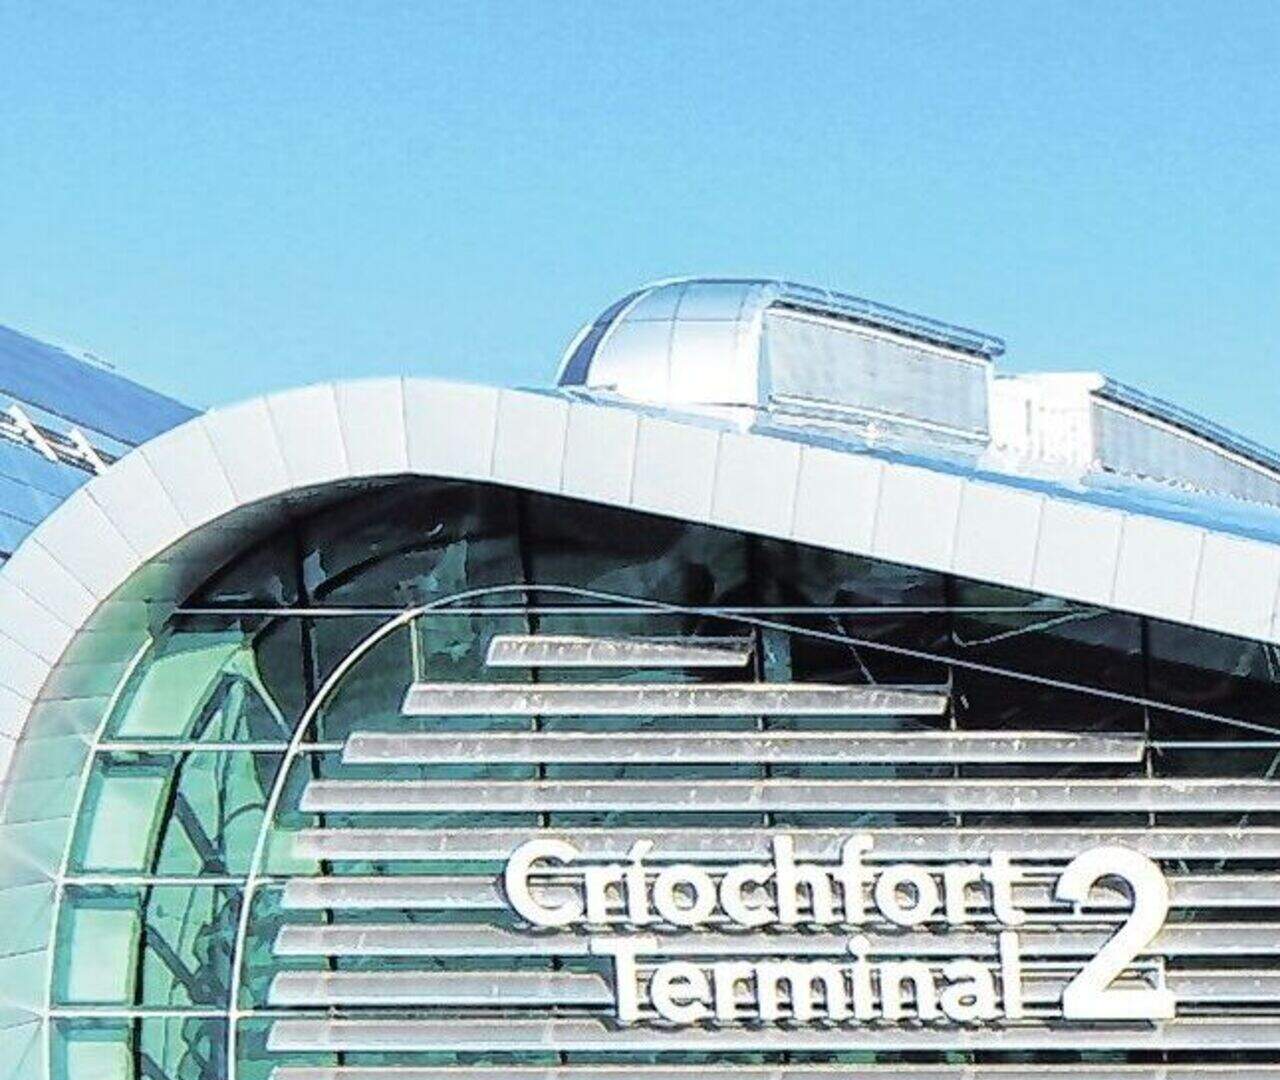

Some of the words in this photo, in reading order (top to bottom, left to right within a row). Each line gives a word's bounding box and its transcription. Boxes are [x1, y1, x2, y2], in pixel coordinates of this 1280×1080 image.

[503, 835, 1025, 927] Críochfort
[591, 932, 1022, 1023] Terminal
[1055, 845, 1175, 1021] 2
